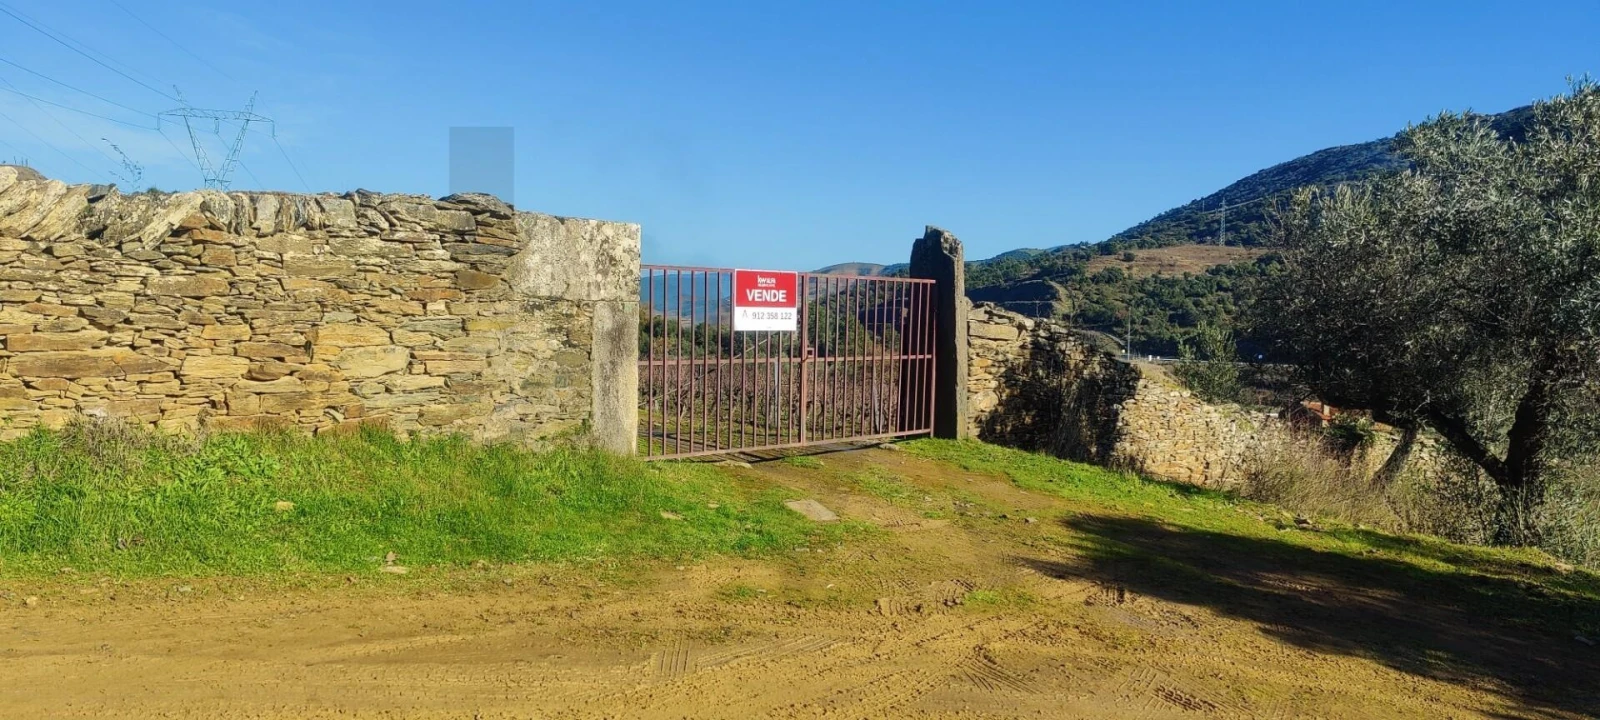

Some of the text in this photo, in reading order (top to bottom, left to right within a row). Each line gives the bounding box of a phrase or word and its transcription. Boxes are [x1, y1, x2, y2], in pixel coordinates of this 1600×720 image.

[746, 289, 787, 302] VENDE
[752, 312, 764, 320] 912
[780, 312, 792, 320] 122
